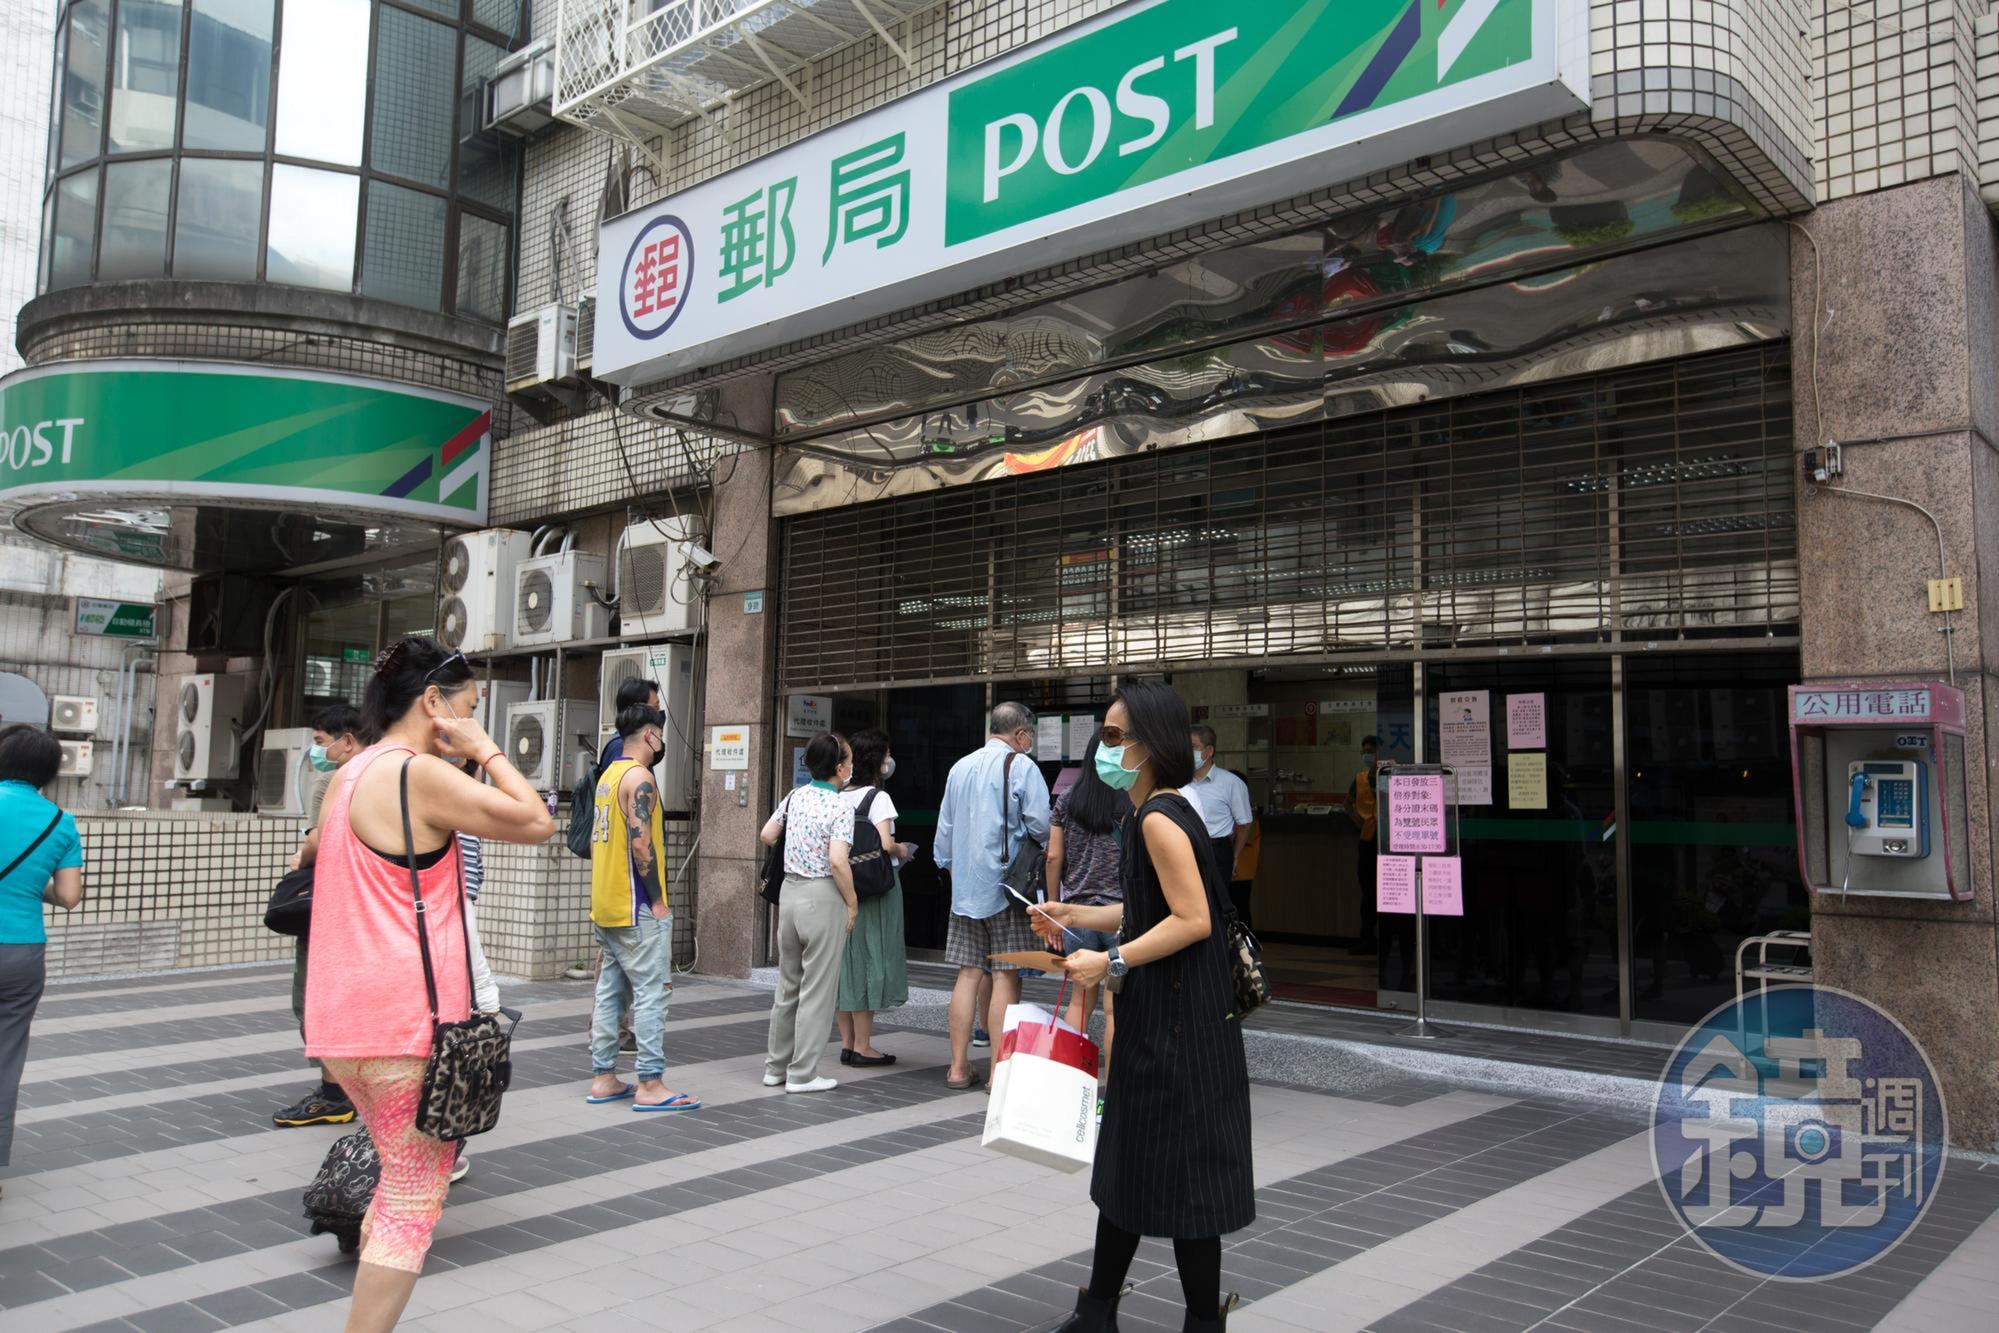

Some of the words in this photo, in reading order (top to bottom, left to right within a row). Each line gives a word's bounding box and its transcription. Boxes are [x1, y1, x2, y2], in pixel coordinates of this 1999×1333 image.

[984, 26, 1238, 203] POST
[717, 131, 912, 304] 郵局
[1802, 691, 1926, 716] 公用電話
